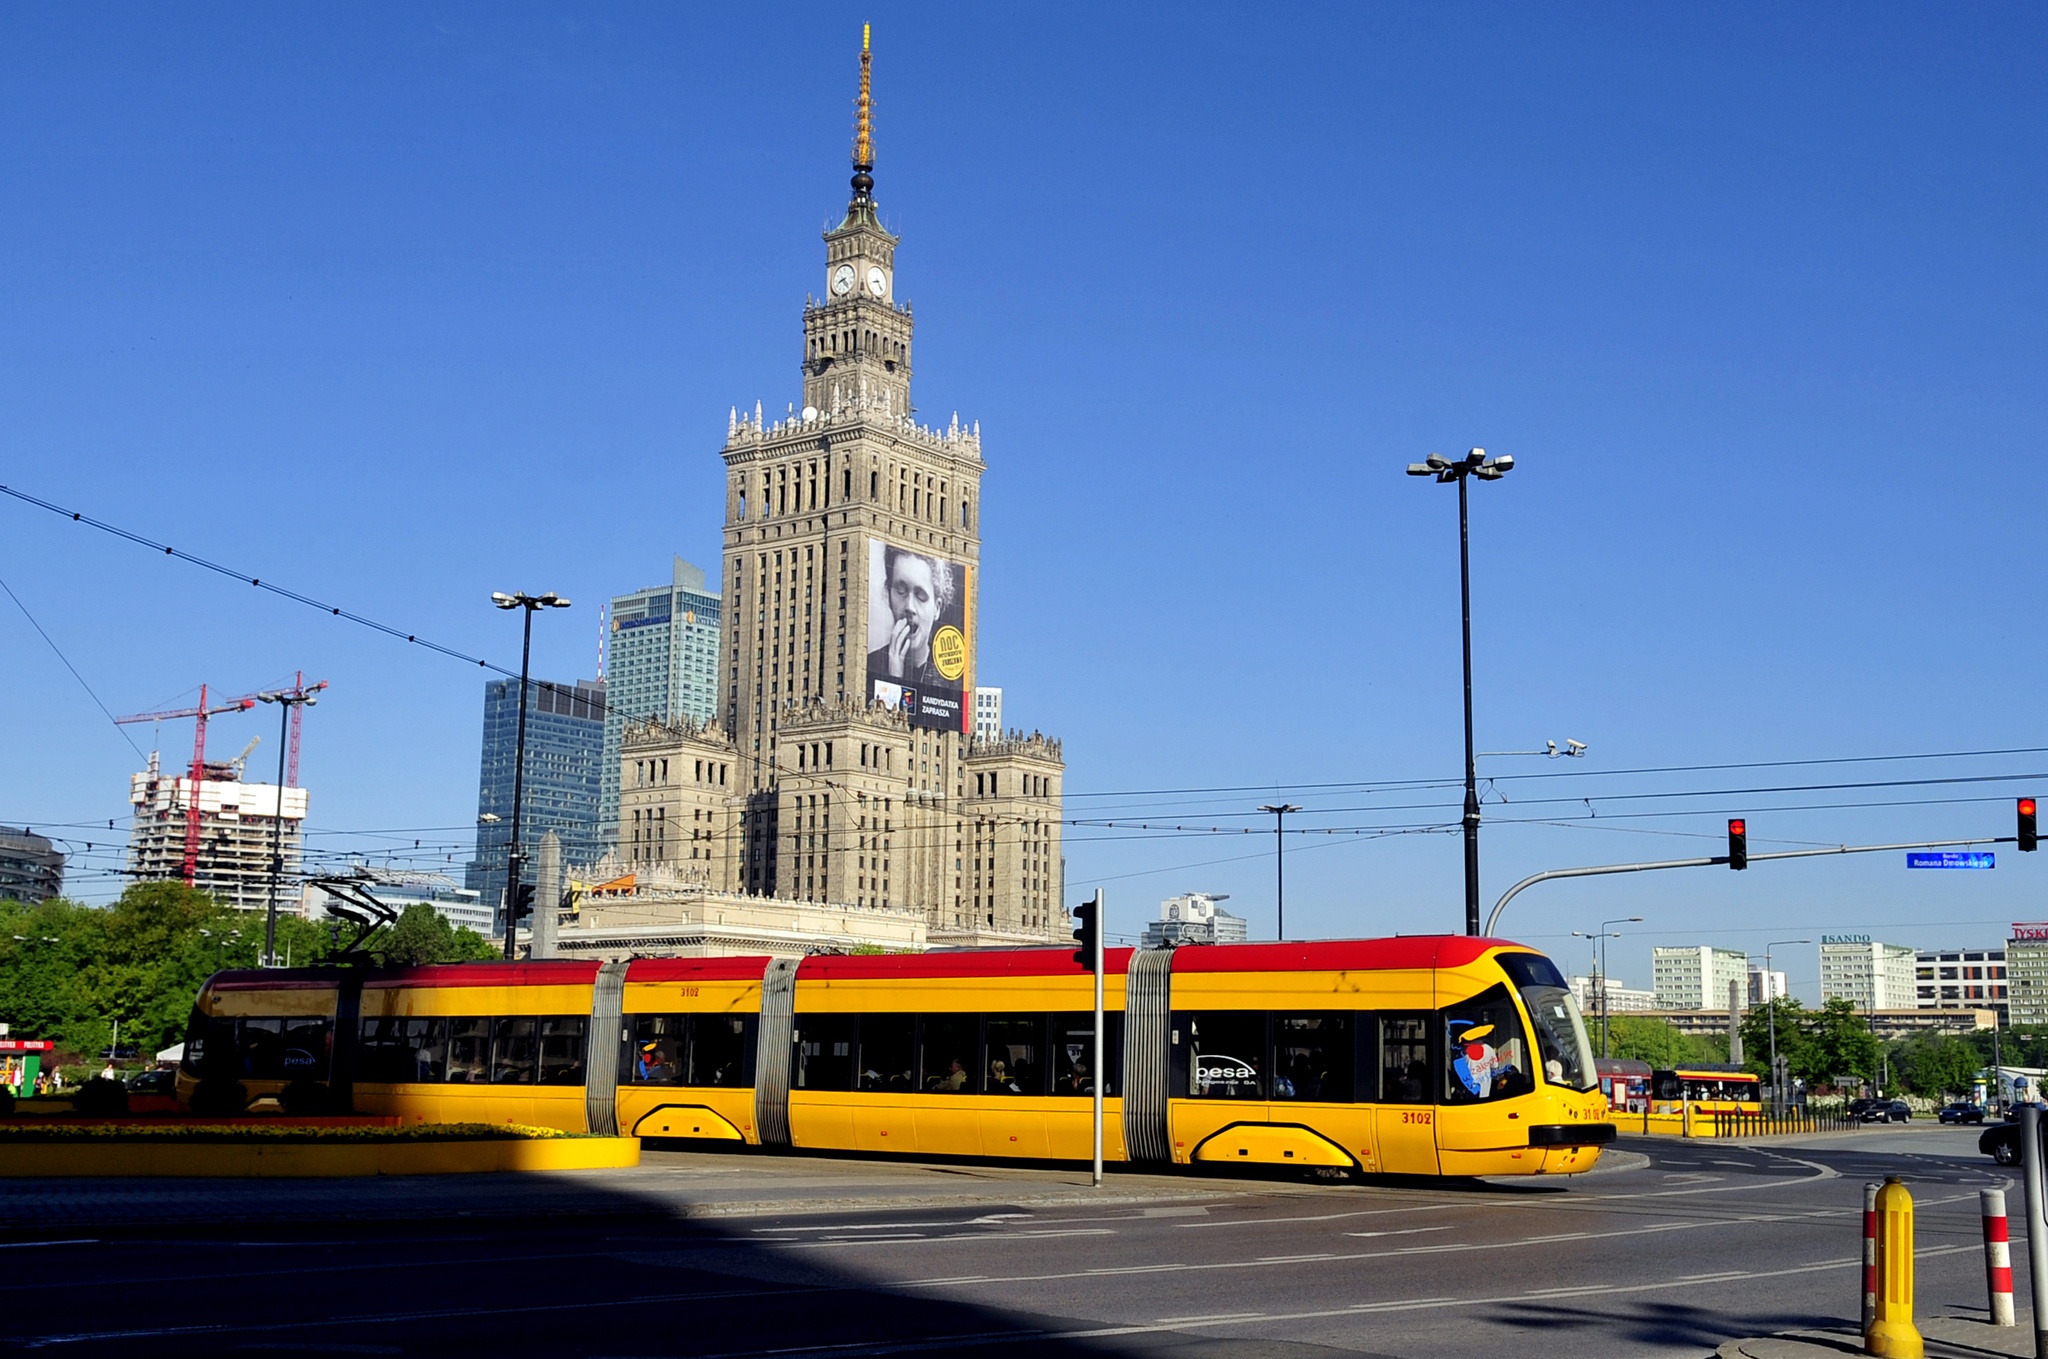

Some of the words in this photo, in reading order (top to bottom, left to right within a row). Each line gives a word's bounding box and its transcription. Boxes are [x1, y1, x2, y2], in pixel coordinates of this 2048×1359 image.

[940, 634, 959, 652] NOC
[922, 695, 959, 709] KANDYDATKA
[922, 706, 950, 718] ZAPRASZA
[1914, 859, 1942, 867] Romana
[1943, 859, 1988, 868] Dmowskiego
[681, 987, 699, 997] 3102
[1196, 1067, 1249, 1082] pesa
[1401, 1111, 1431, 1125] 3102
